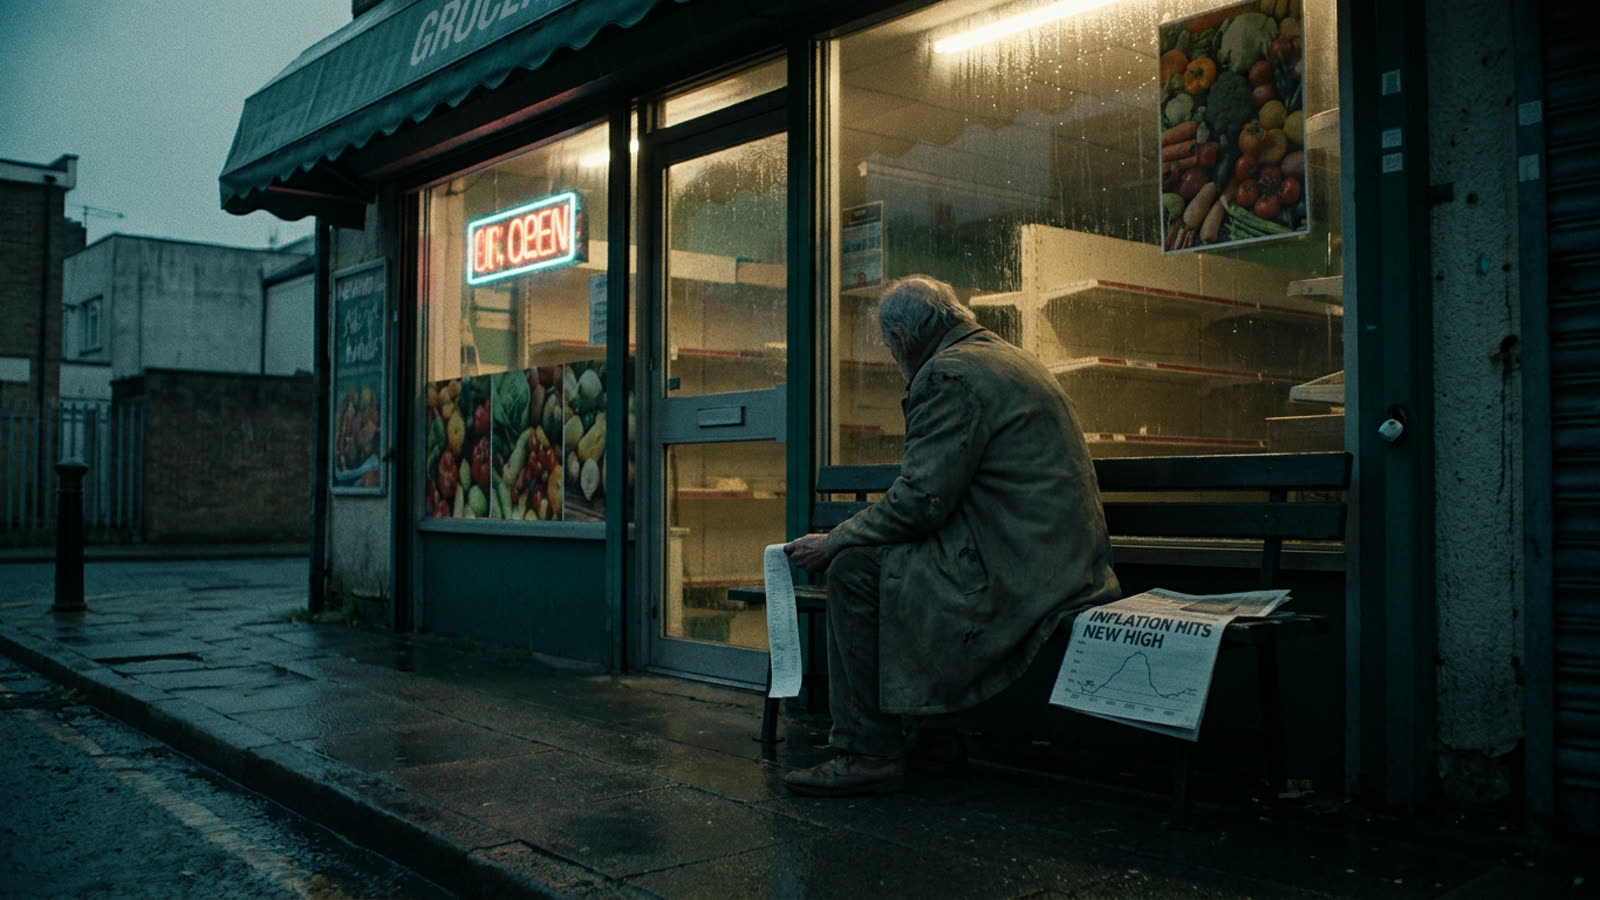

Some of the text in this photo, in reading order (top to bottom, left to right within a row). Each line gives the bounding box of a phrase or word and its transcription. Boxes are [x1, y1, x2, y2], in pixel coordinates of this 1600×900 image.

[410, 0, 529, 66] GROC
[507, 203, 570, 265] OPEN
[1082, 624, 1165, 649] NEW HIGH
[1089, 611, 1174, 631] INFLATION
